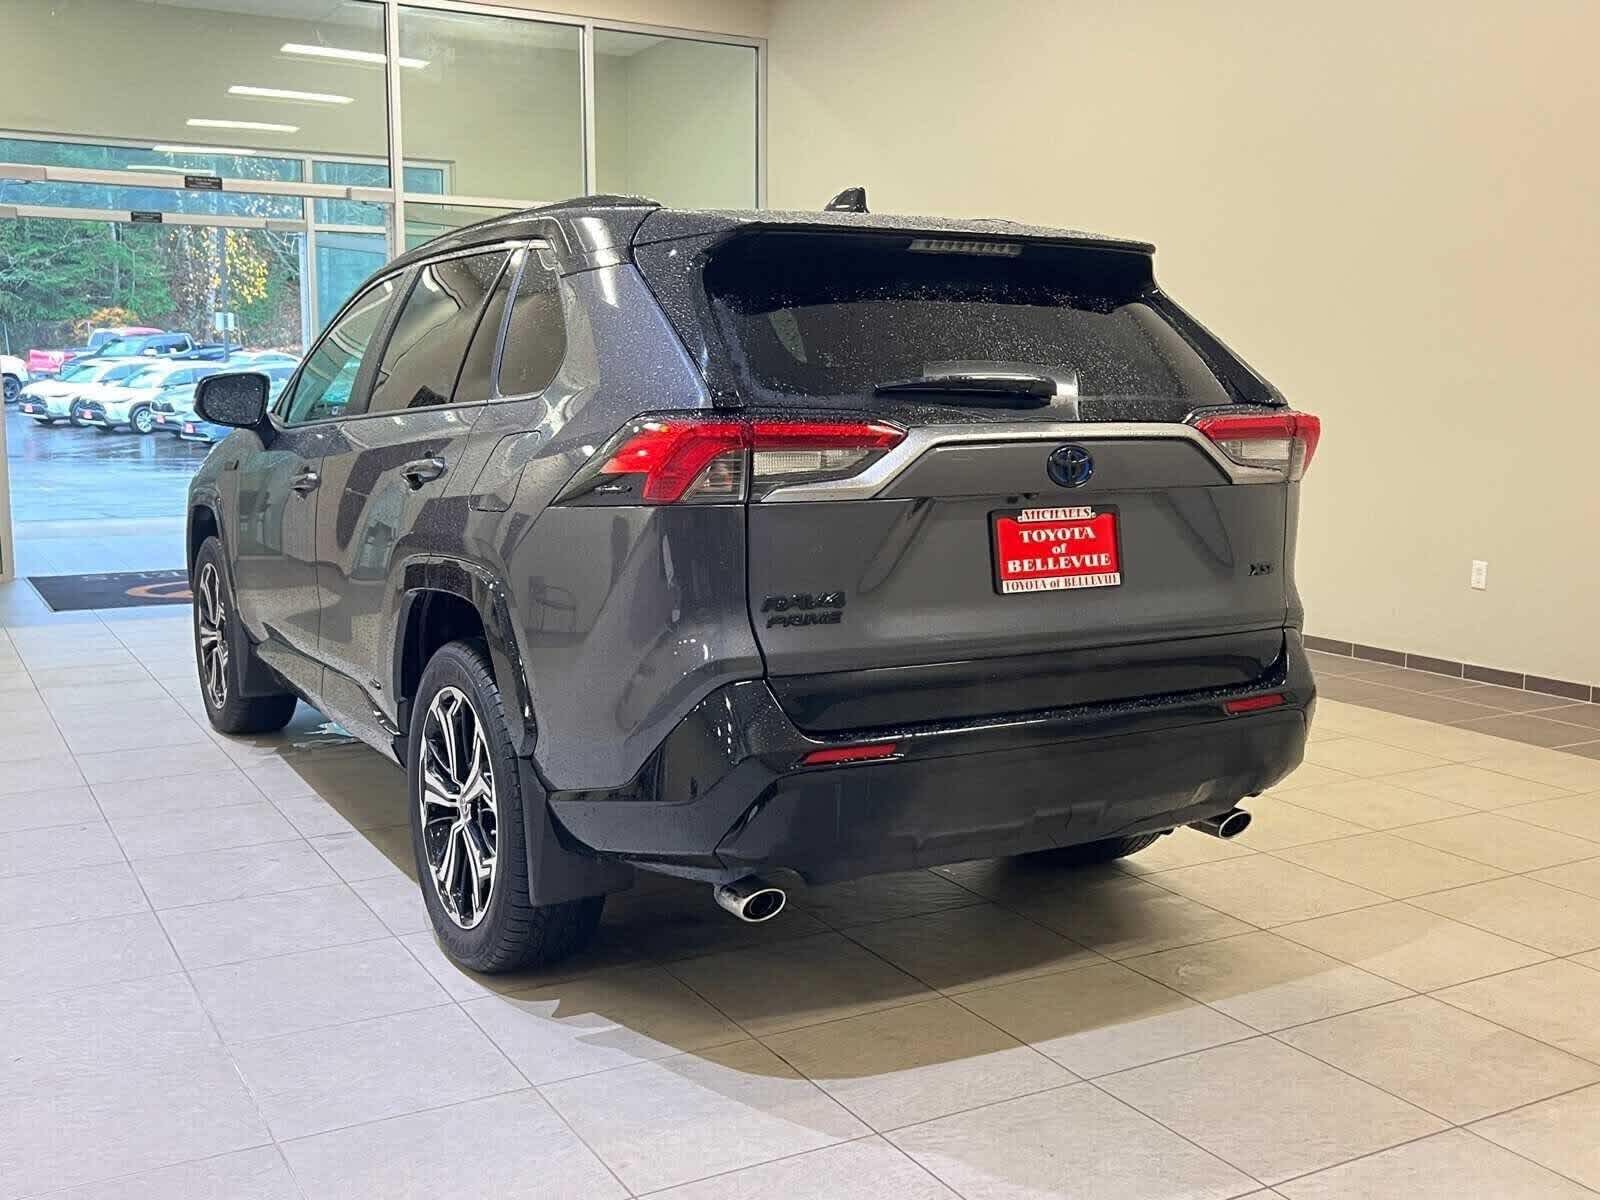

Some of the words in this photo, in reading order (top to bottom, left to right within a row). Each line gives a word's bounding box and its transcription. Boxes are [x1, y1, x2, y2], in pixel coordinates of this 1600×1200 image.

[1022, 507, 1091, 521] MICHAELS
[1020, 526, 1096, 543] TOYOTA
[1051, 543, 1067, 555] of
[1007, 553, 1112, 573] BELLEVUE
[1004, 578, 1047, 592] TOYOTA
[1050, 578, 1061, 588] of
[1064, 573, 1118, 587] BELLEVUE
